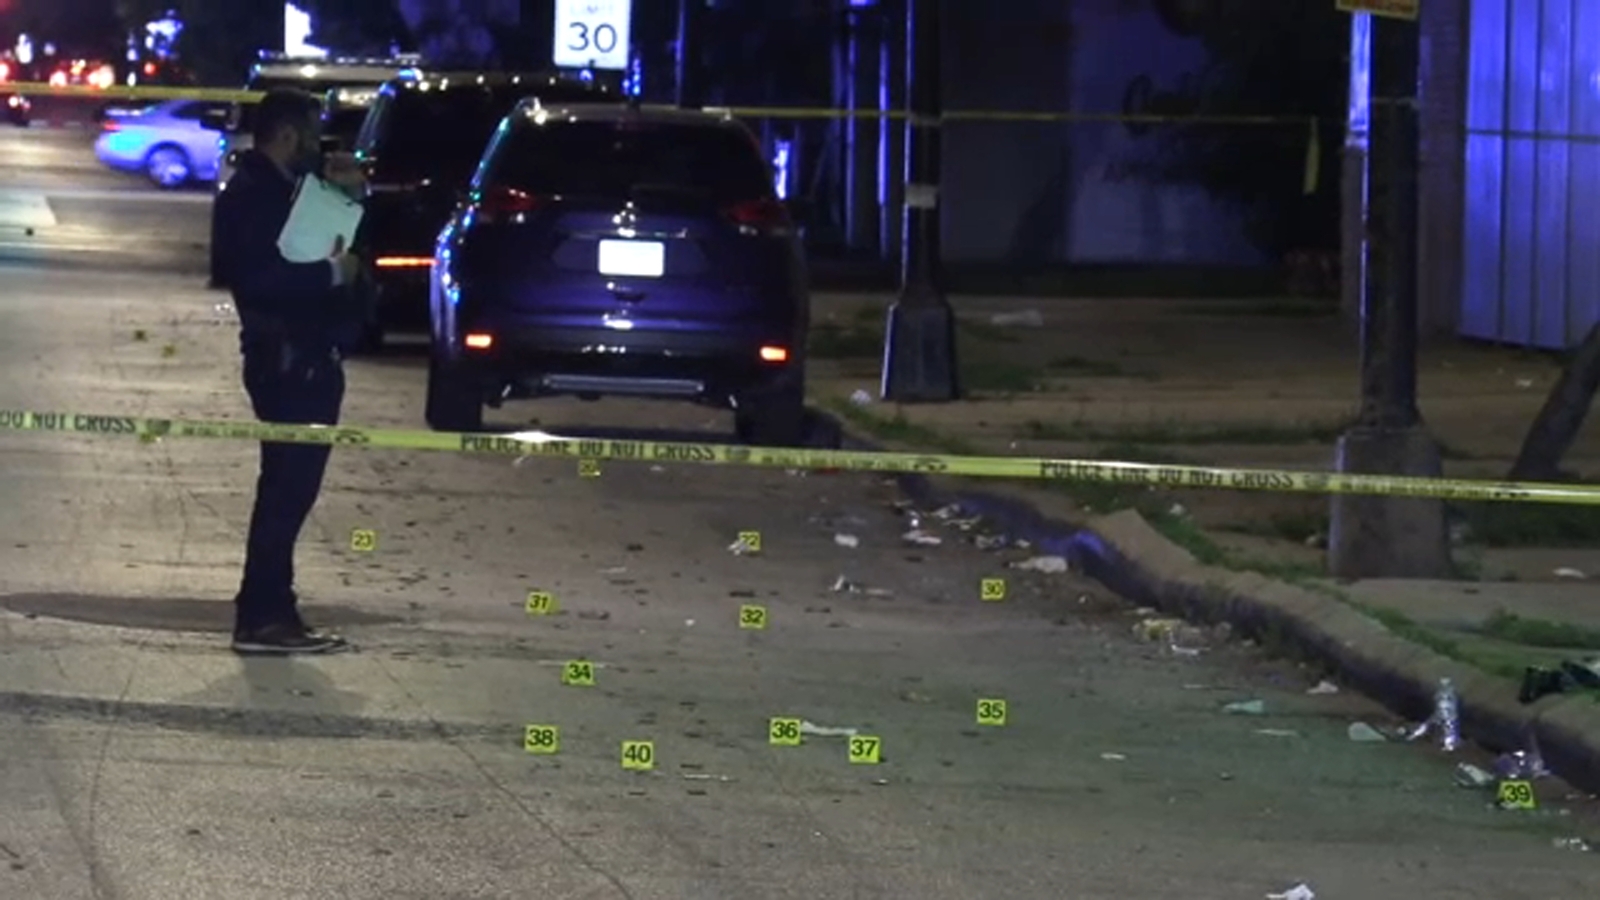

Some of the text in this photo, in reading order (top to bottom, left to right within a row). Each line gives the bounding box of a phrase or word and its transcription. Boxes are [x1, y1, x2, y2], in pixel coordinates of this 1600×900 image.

[568, 22, 617, 53] 30
[0, 410, 136, 433] DO NOT CROSS
[461, 434, 521, 453] POLICE
[580, 440, 603, 456] DO
[611, 441, 644, 458] NOT
[654, 443, 716, 461] CROSS
[1231, 471, 1294, 489] CROSS
[354, 533, 371, 547] 23
[984, 582, 1000, 596] 30
[530, 594, 548, 610] 31
[741, 609, 763, 624] 32
[569, 663, 591, 680] 34
[979, 702, 1003, 719] 35
[526, 729, 554, 747] 38
[772, 721, 798, 739] 36
[624, 744, 651, 763] 40
[851, 739, 876, 757] 37
[1504, 784, 1530, 802] 39
